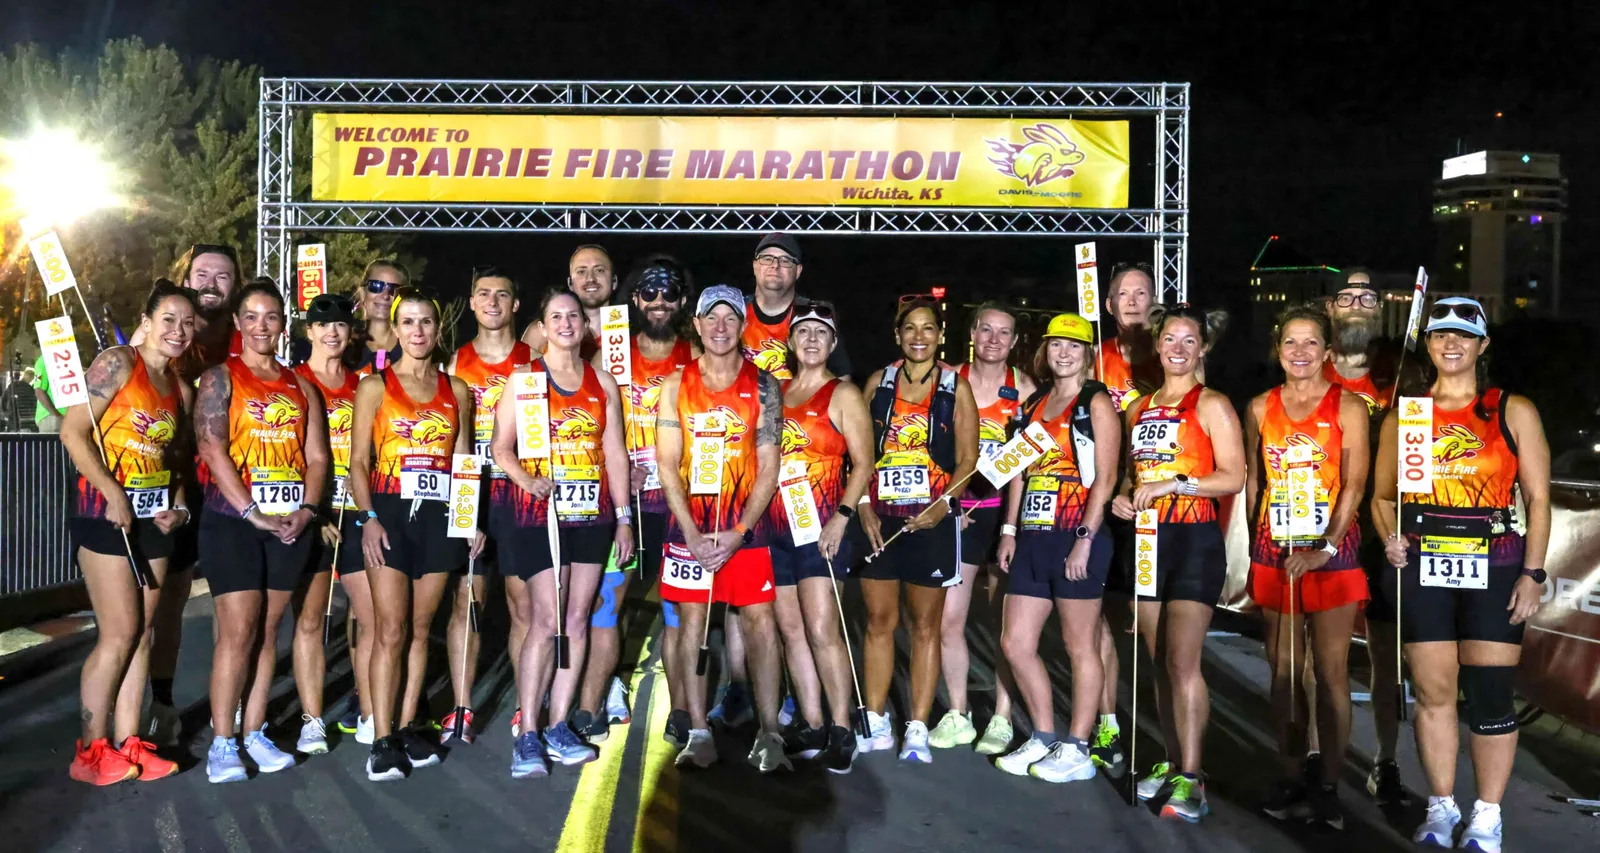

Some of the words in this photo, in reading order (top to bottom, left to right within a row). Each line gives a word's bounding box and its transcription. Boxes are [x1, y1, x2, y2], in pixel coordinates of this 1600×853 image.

[334, 126, 439, 143] WELCOME
[446, 129, 470, 143] TO
[353, 147, 553, 179] PRAIRIE
[563, 149, 675, 180] FIRE
[684, 149, 962, 182] MARATHON
[841, 186, 914, 201] Wichita,
[919, 187, 945, 201] KS
[1083, 272, 1095, 314] 4:00
[609, 335, 625, 376] 3:30
[53, 349, 80, 396] 2:15
[250, 428, 279, 438] PRAIRIE
[280, 429, 297, 439] FIRE
[524, 404, 545, 449] 5:00
[1138, 424, 1168, 440] 266
[699, 442, 719, 485] 3:00
[724, 449, 742, 458] FIRE
[995, 442, 1033, 475] 3:00
[1405, 432, 1425, 481] 3:00
[883, 470, 924, 487] 1259
[1453, 463, 1478, 475] FIRE
[418, 473, 438, 490] 60
[259, 486, 300, 503] 1780
[414, 490, 441, 498] Stephanie
[556, 485, 596, 501] 1715
[1024, 495, 1052, 511] 452
[1292, 471, 1309, 518] 2:00
[455, 484, 475, 528] 4:30
[789, 485, 813, 529] 2:30
[671, 561, 702, 581] 369
[1138, 539, 1152, 586] 4:00
[1429, 558, 1479, 578] 1311
[1446, 578, 1461, 586] Amy
